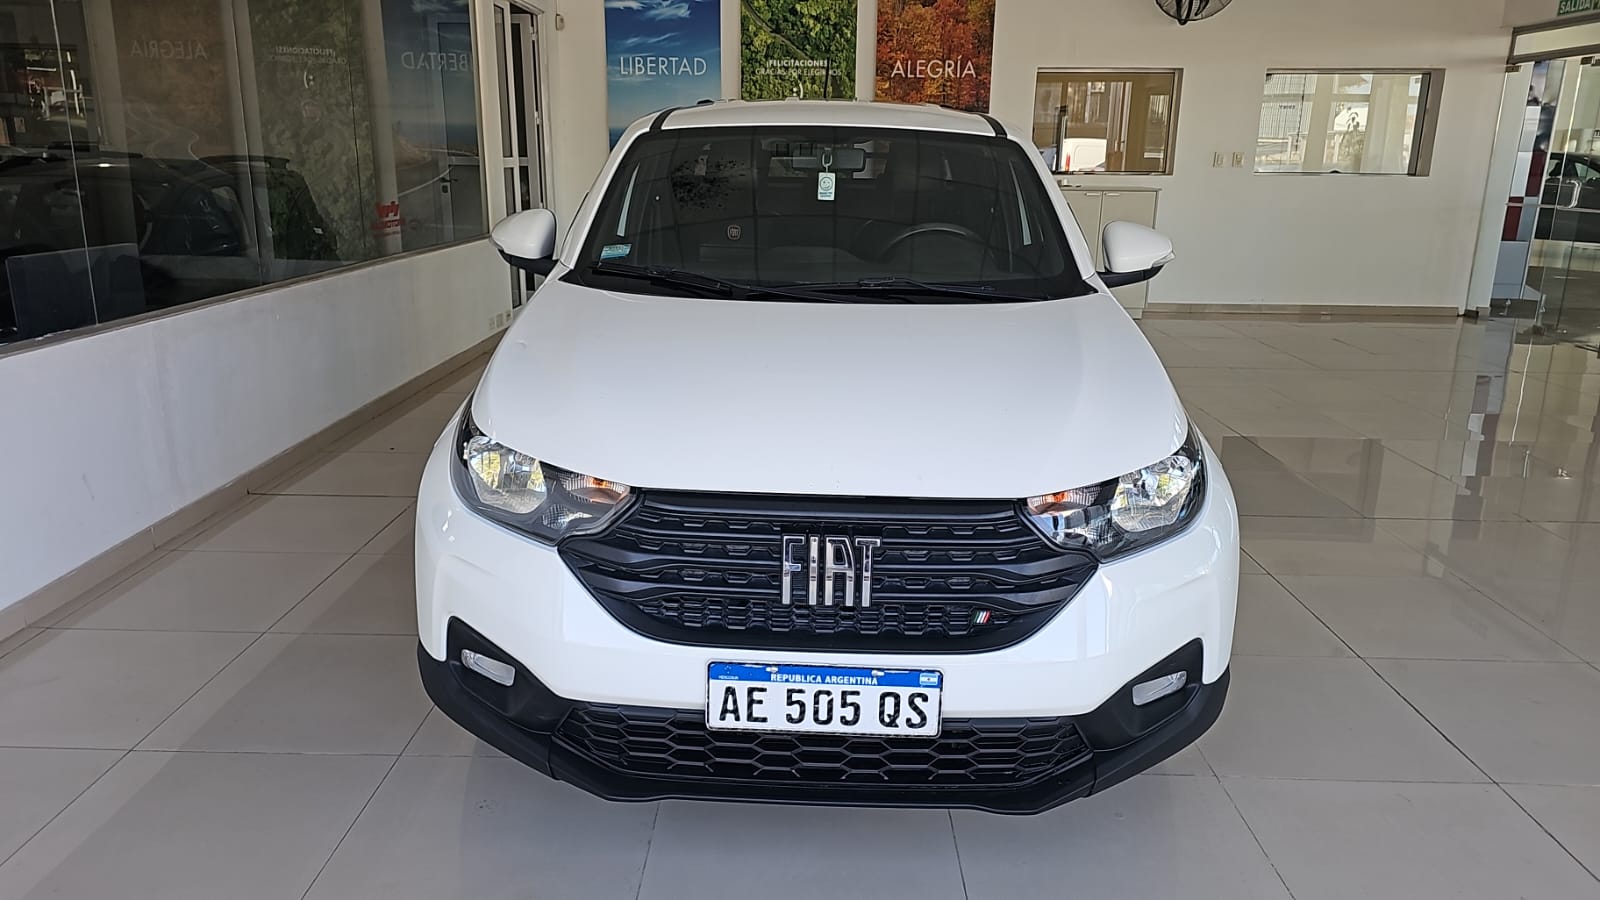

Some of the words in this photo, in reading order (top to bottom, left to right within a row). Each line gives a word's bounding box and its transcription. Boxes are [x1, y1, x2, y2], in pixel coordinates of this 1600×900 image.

[1560, 0, 1591, 14] SALIDA
[620, 56, 707, 76] LIBERTAD
[755, 68, 787, 77] GRACIAS
[789, 68, 802, 77] POR
[890, 54, 977, 78] ALEGRÍA
[782, 534, 881, 607] FIAT
[770, 673, 822, 684] REPUBLICA
[824, 675, 878, 686] ARGENTINA
[719, 686, 768, 723] AE
[785, 688, 860, 727] 505
[878, 691, 929, 729] QS
